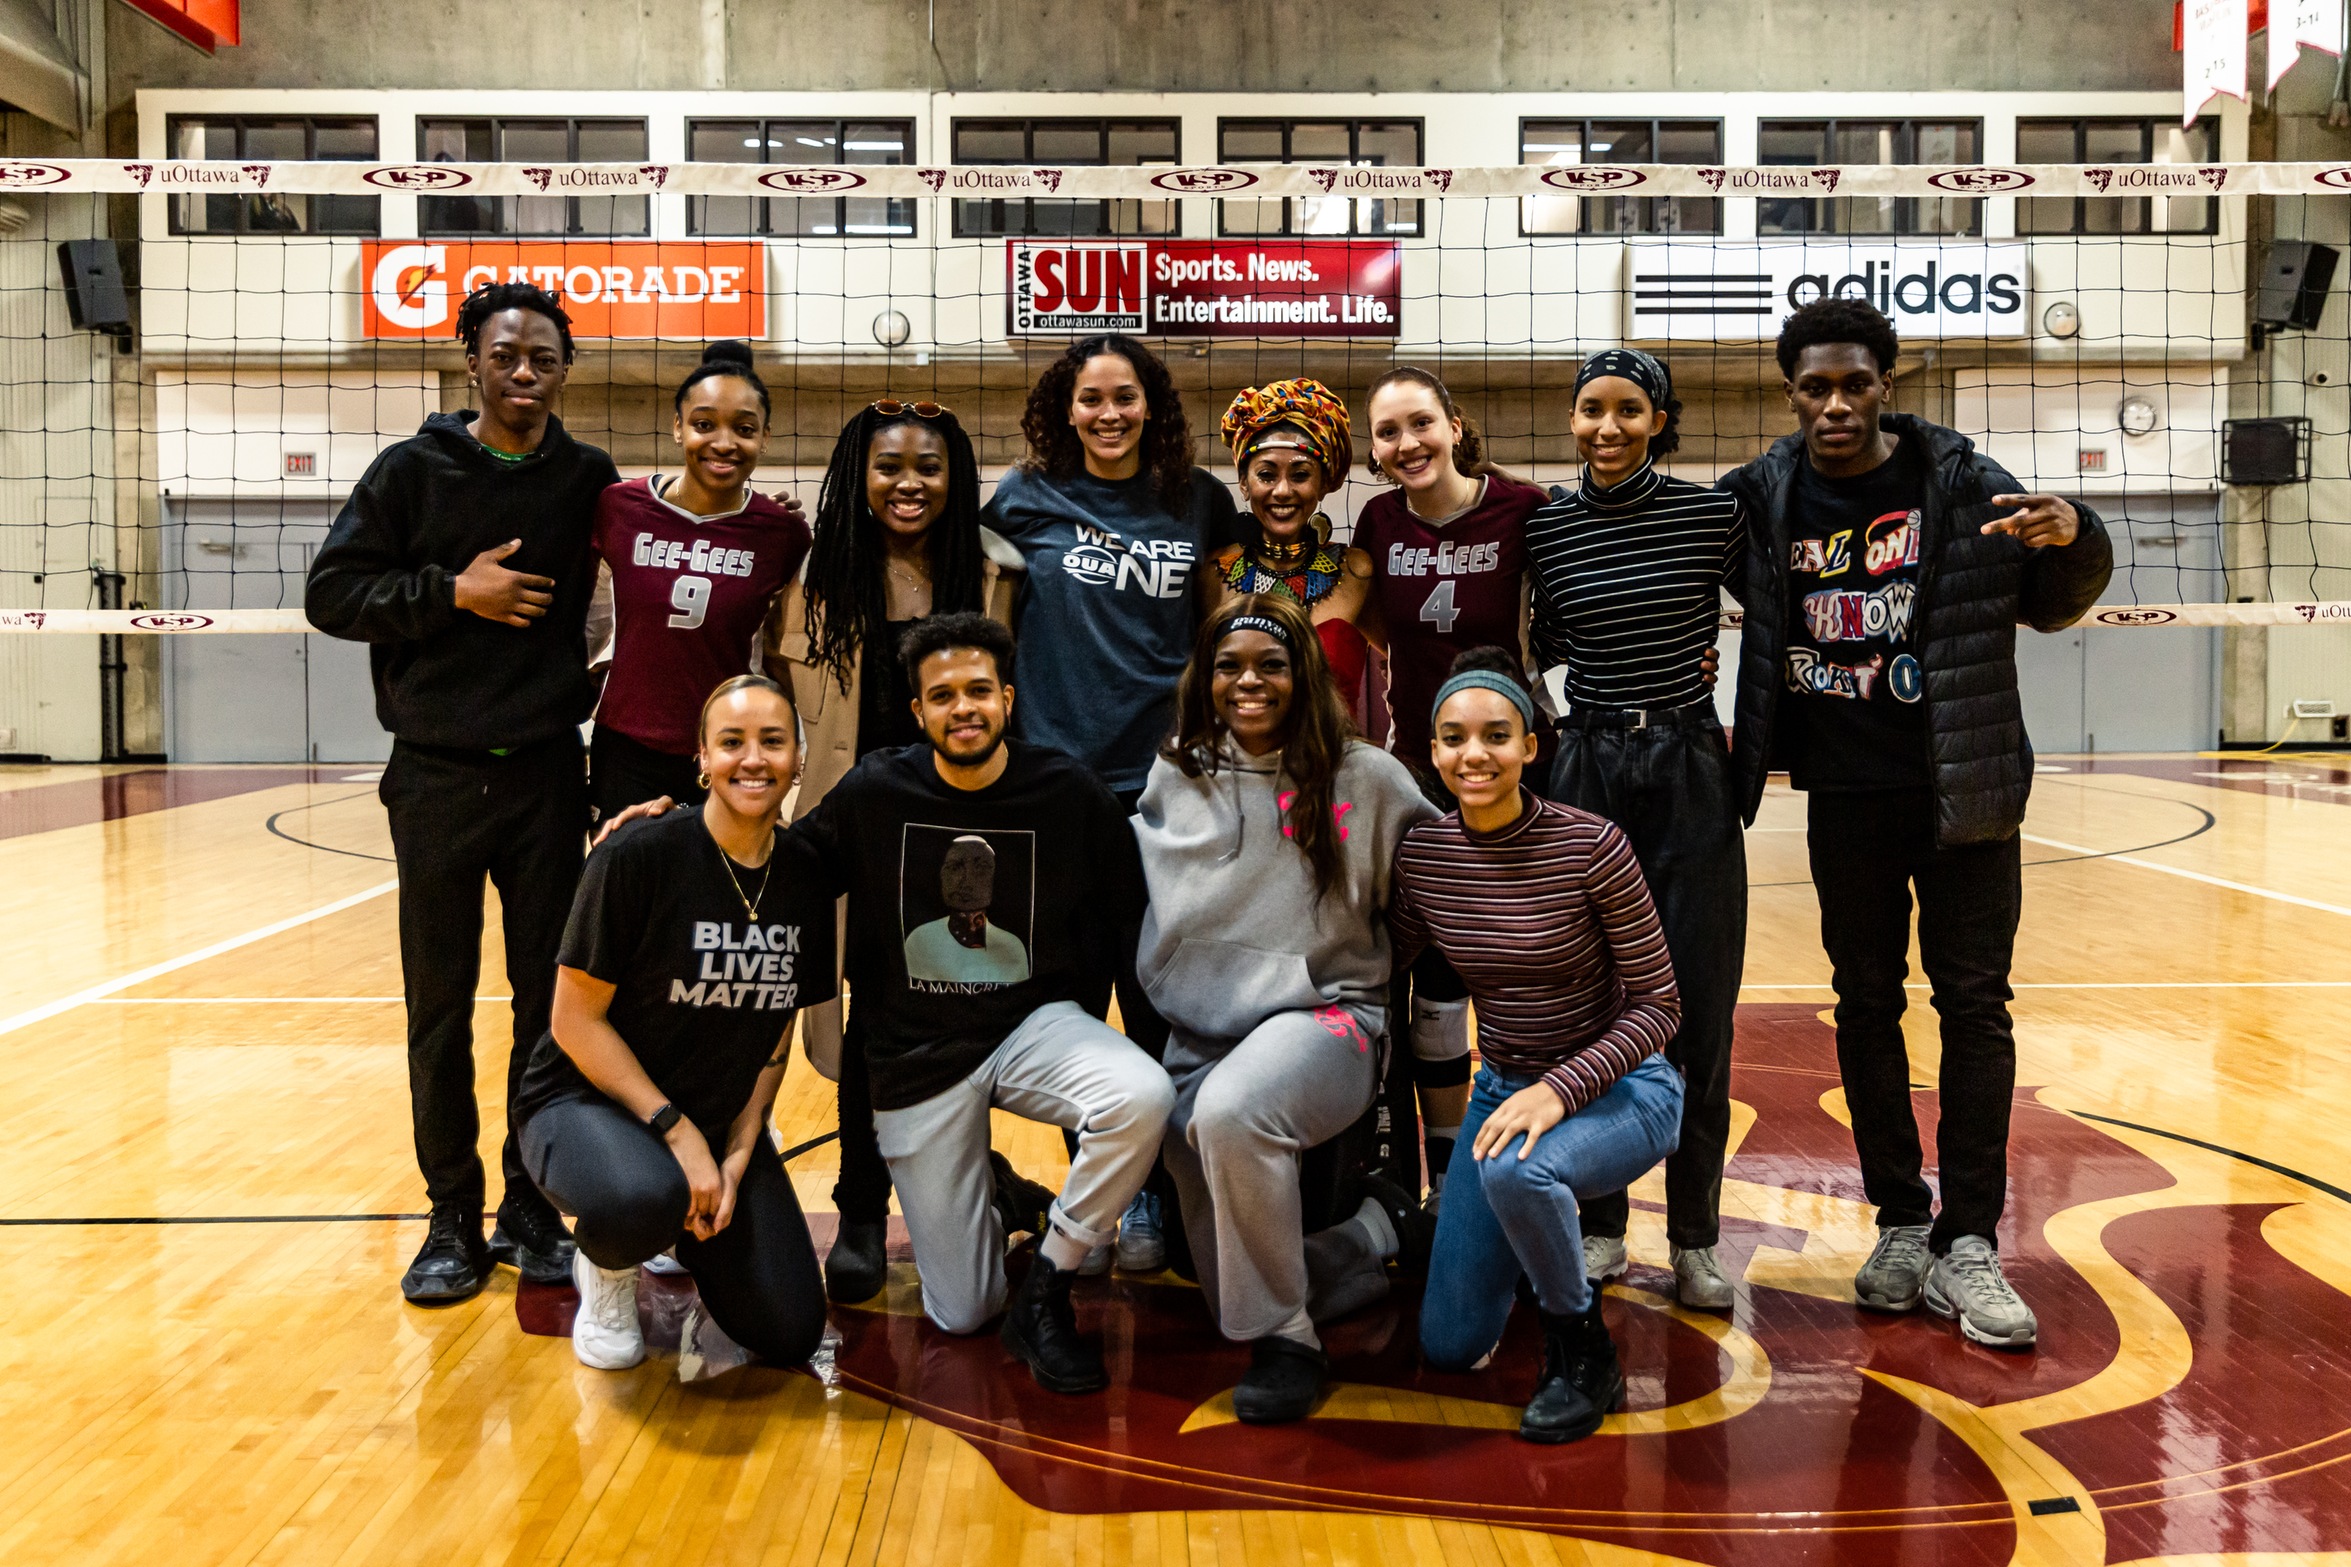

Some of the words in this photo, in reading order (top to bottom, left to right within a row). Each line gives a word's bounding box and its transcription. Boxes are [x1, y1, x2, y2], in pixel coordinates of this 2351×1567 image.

[161, 165, 239, 183] uOttawa
[560, 168, 638, 187] uOttawa
[953, 170, 1031, 188] uOttawa
[1344, 170, 1421, 188] uOttawa
[1732, 170, 1809, 188] uOttawa
[2118, 169, 2196, 187] uOttawa
[1034, 250, 1141, 312] SUN
[1154, 252, 1243, 288] Sports.
[1248, 253, 1320, 282] News.
[1018, 251, 1031, 328] OTTAWA
[1787, 260, 2021, 315] adidas
[1040, 316, 1136, 328] ottawasun.com
[1154, 295, 1337, 323] Entertainment.
[1343, 295, 1394, 324] Life.
[288, 455, 313, 472] EXIT
[2080, 451, 2104, 468] EXIT
[1075, 523, 1127, 550] WE
[1129, 540, 1196, 561] ARE
[1062, 554, 1116, 577] OUA
[668, 575, 712, 630] 9
[1419, 580, 1461, 633] 4
[1802, 580, 1916, 643] KNOW
[694, 921, 801, 952] BLACK
[700, 951, 795, 982] LIVES
[669, 978, 799, 1010] MATTER
[909, 976, 926, 992] LA
